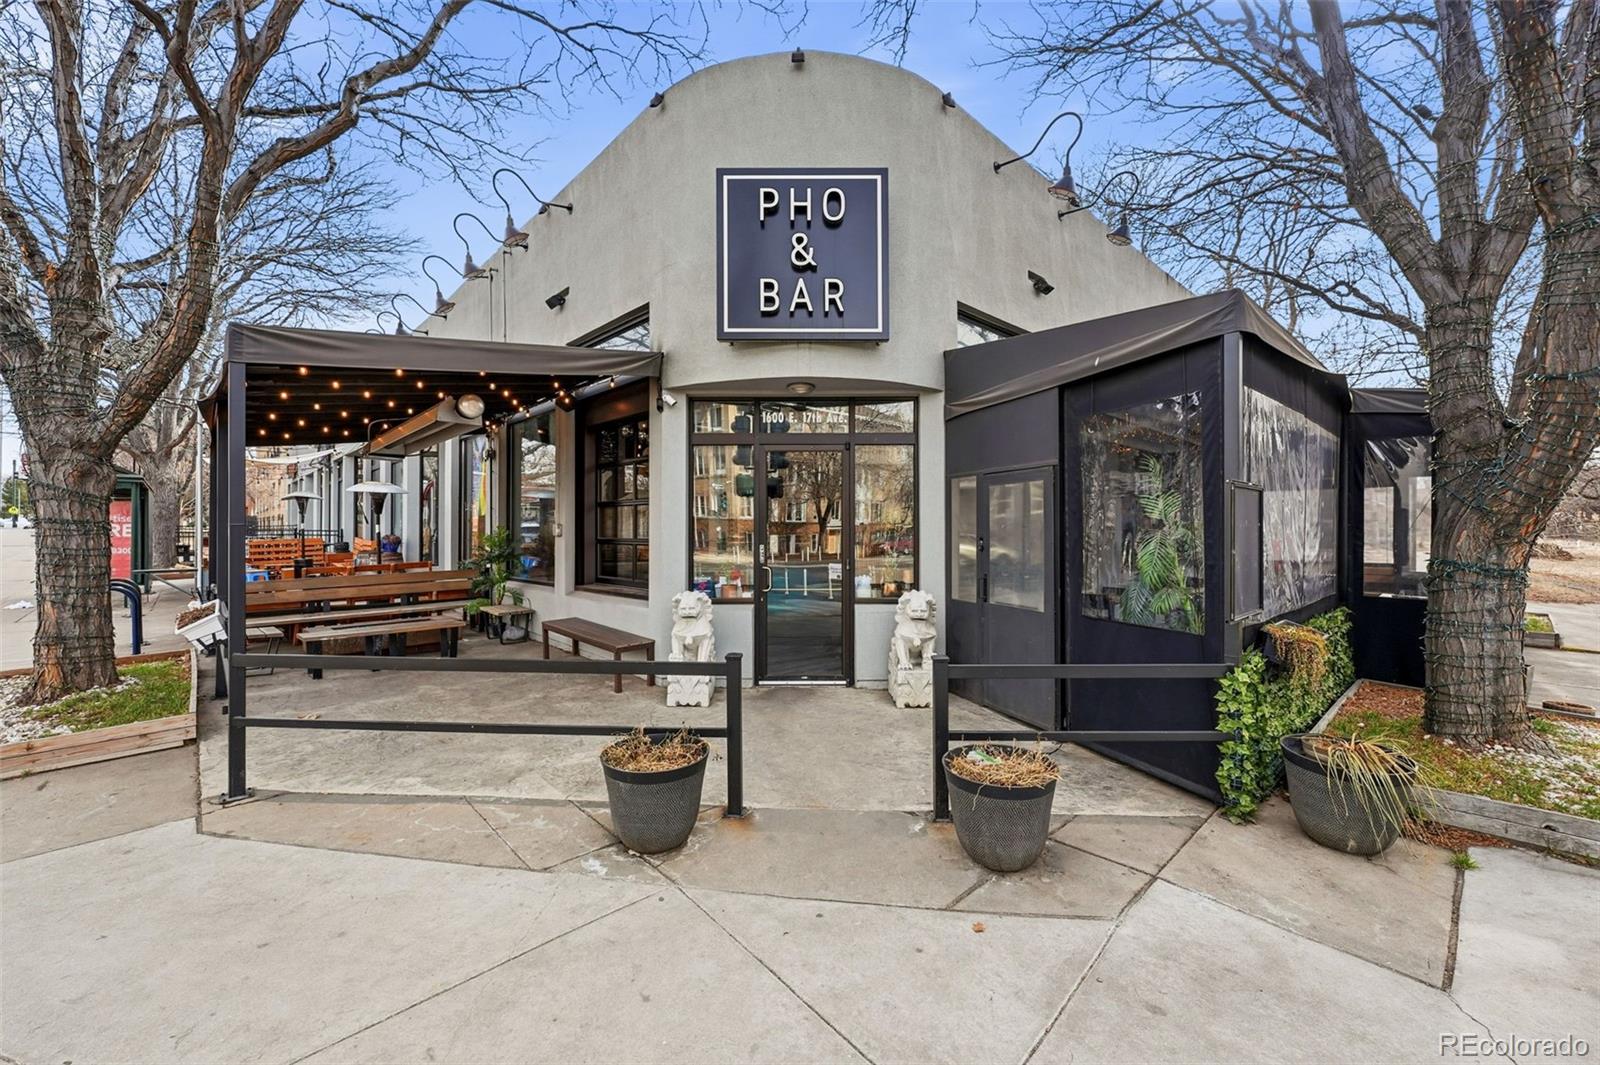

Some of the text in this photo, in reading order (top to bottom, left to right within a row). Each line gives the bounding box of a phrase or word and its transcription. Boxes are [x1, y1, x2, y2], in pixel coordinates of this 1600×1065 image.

[759, 187, 846, 222] PHO
[790, 232, 818, 267] &
[759, 278, 845, 312] BAR
[762, 412, 848, 423] 1600 E. 17th Ave.
